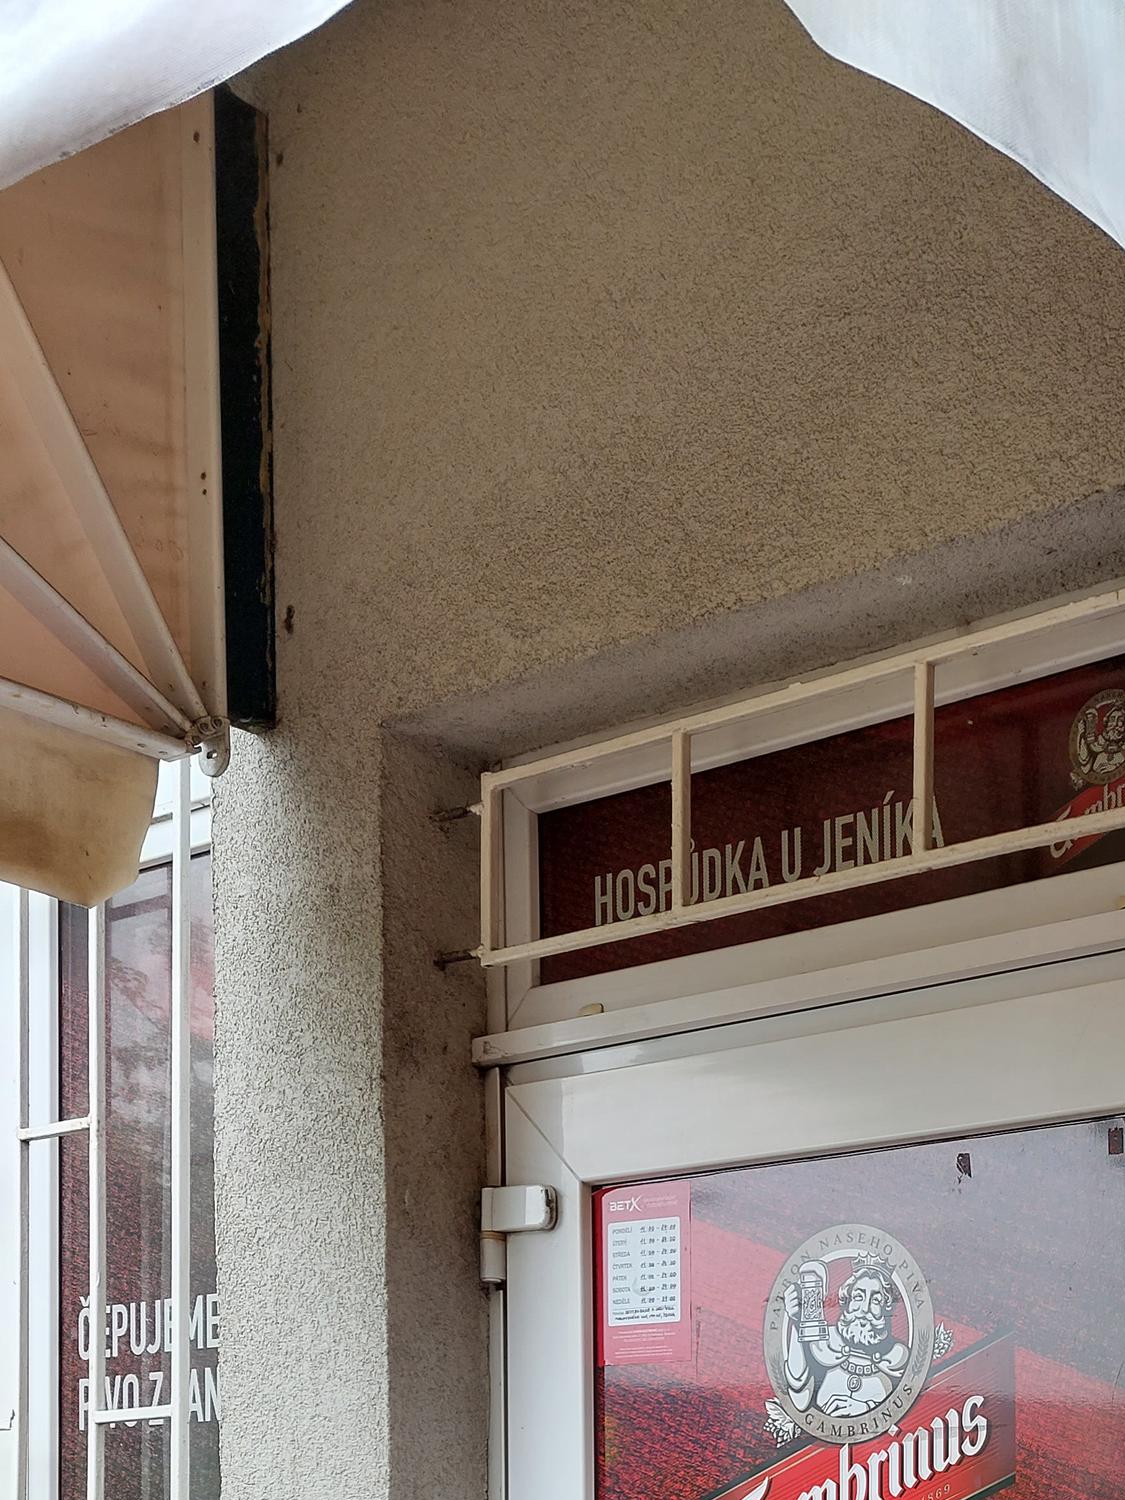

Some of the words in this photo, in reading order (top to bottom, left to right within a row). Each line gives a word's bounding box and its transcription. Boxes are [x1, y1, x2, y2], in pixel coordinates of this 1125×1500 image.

[781, 827, 802, 883] U
[899, 1260, 926, 1310] PIVA
[79, 1373, 140, 1430] PVO
[805, 1384, 913, 1437] GAMBRINUS
